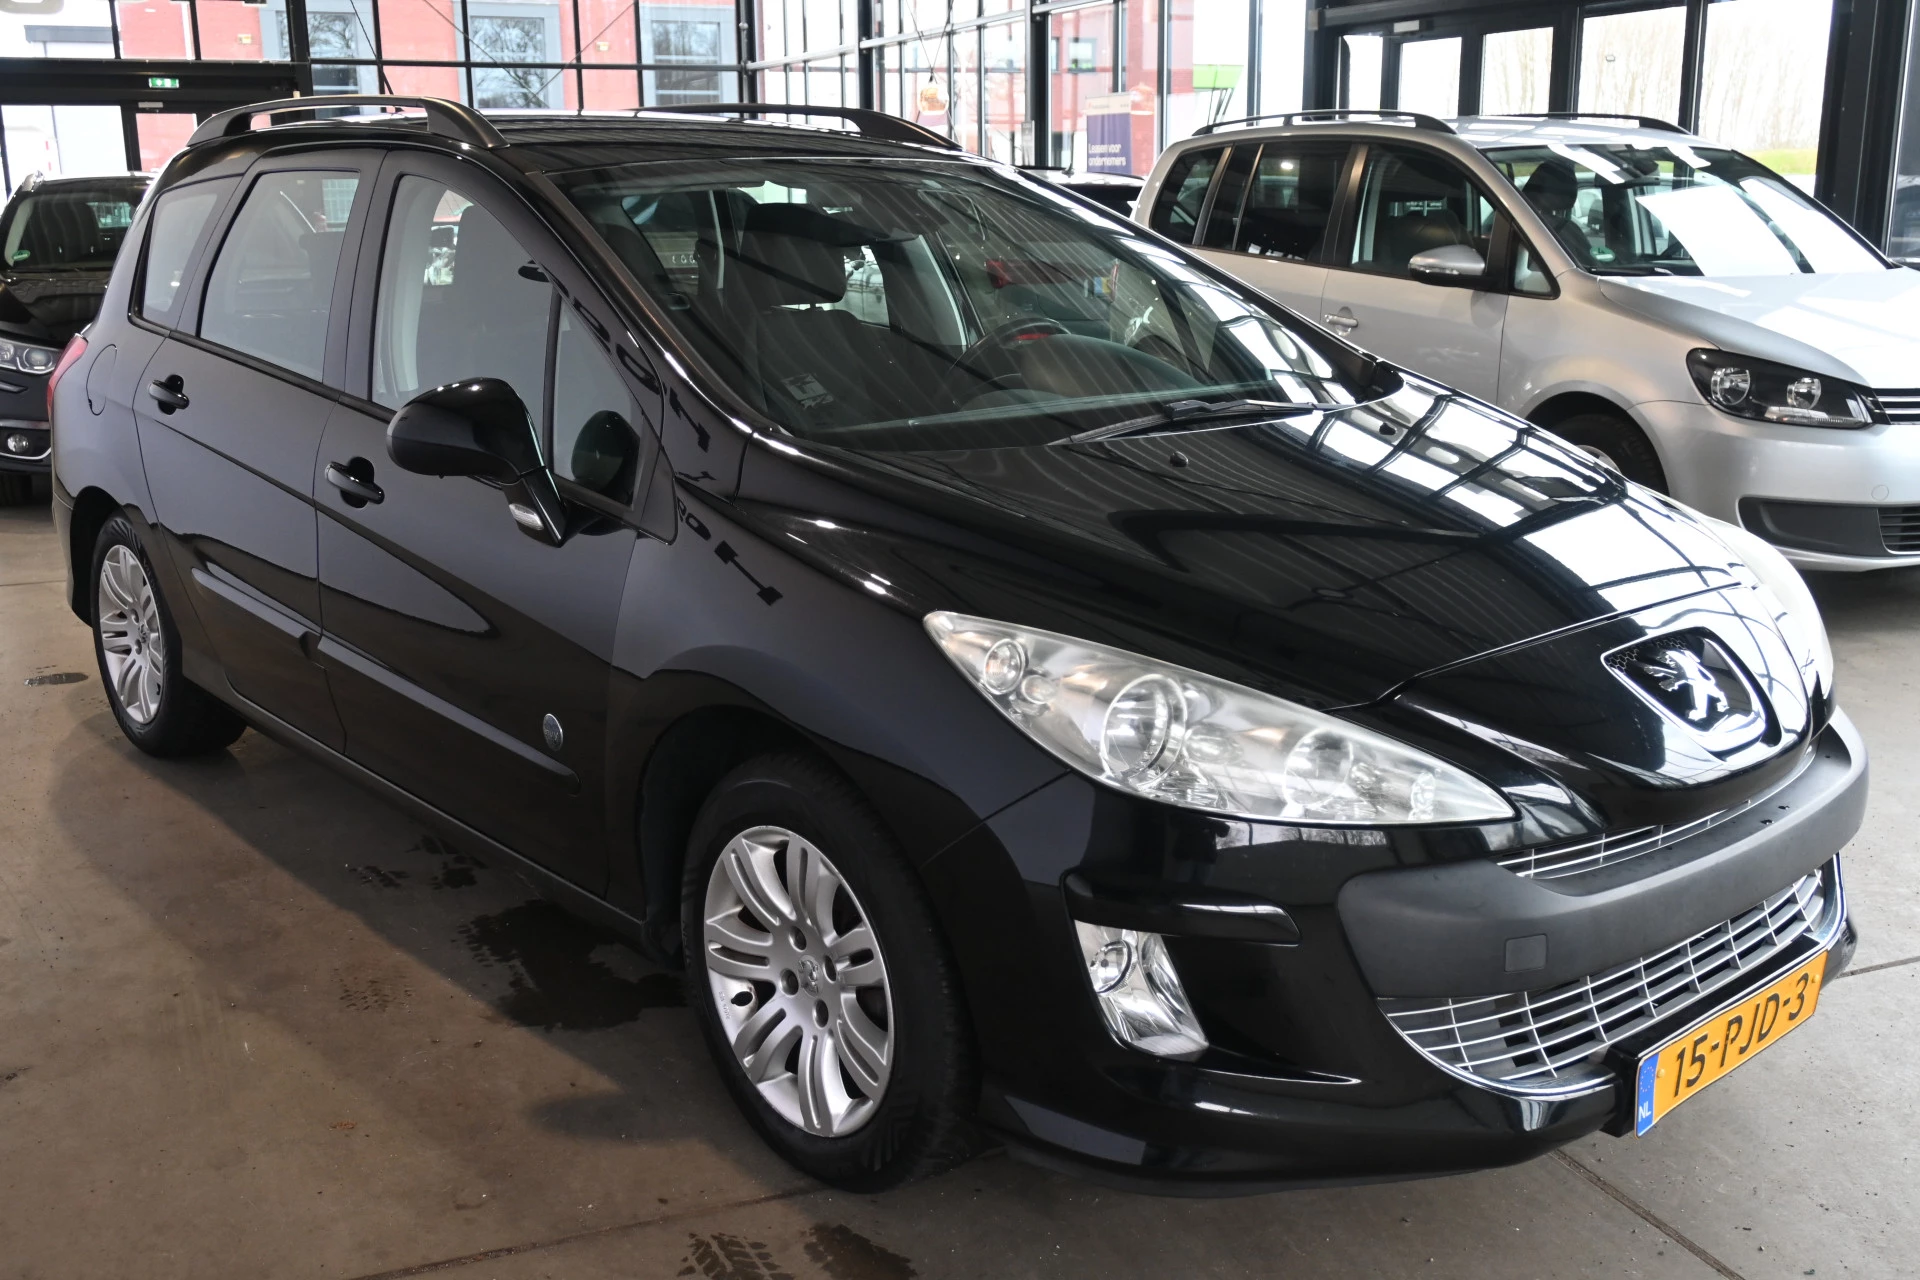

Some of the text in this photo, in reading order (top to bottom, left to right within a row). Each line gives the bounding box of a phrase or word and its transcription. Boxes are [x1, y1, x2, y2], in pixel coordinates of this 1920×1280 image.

[1108, 144, 1121, 153] voor
[1088, 156, 1126, 166] ondernemers
[1673, 972, 1809, 1098] 15-PJD-3
[1638, 1100, 1652, 1122] NL
